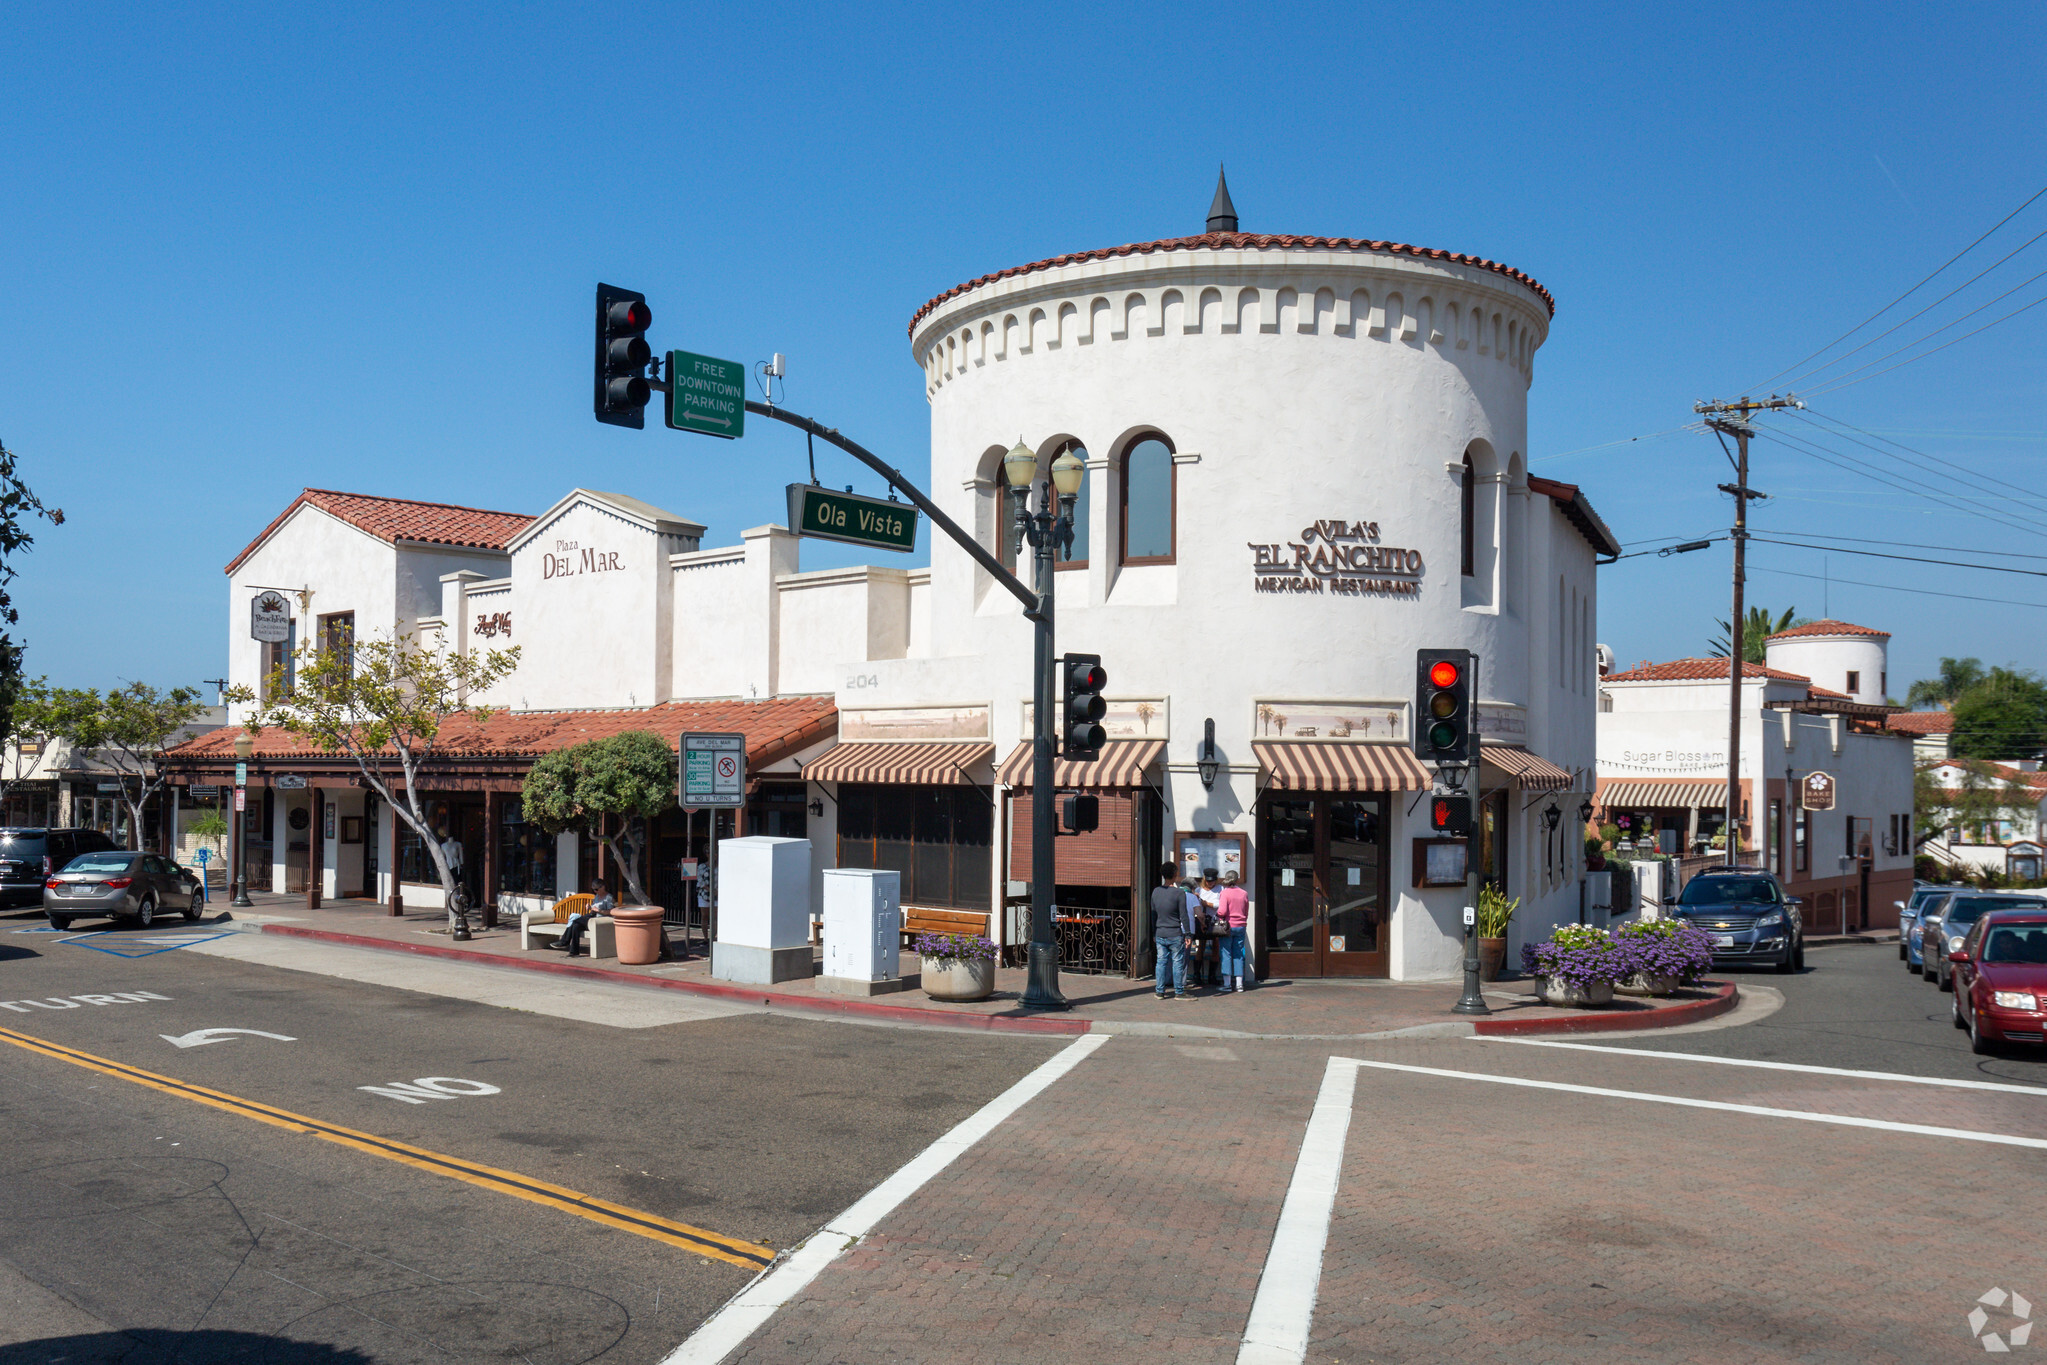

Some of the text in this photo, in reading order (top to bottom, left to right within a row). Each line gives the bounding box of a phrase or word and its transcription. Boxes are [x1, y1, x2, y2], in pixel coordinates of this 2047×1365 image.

[694, 361, 726, 378] FREE
[678, 375, 741, 398] DOWNTOWN
[684, 393, 735, 414] PARKING
[818, 502, 903, 537] Ola Vista
[1301, 519, 1379, 542] AVILA'S
[556, 539, 579, 552] Plaza
[543, 546, 626, 580] DEL MAR
[1247, 541, 1423, 576] EL RANCHITO
[1254, 576, 1419, 595] MEXICAN RESTAURANT
[846, 674, 879, 689] 204
[1623, 750, 1662, 765] Sugar
[0, 991, 175, 1013] TURN
[356, 1076, 502, 1105] NO
